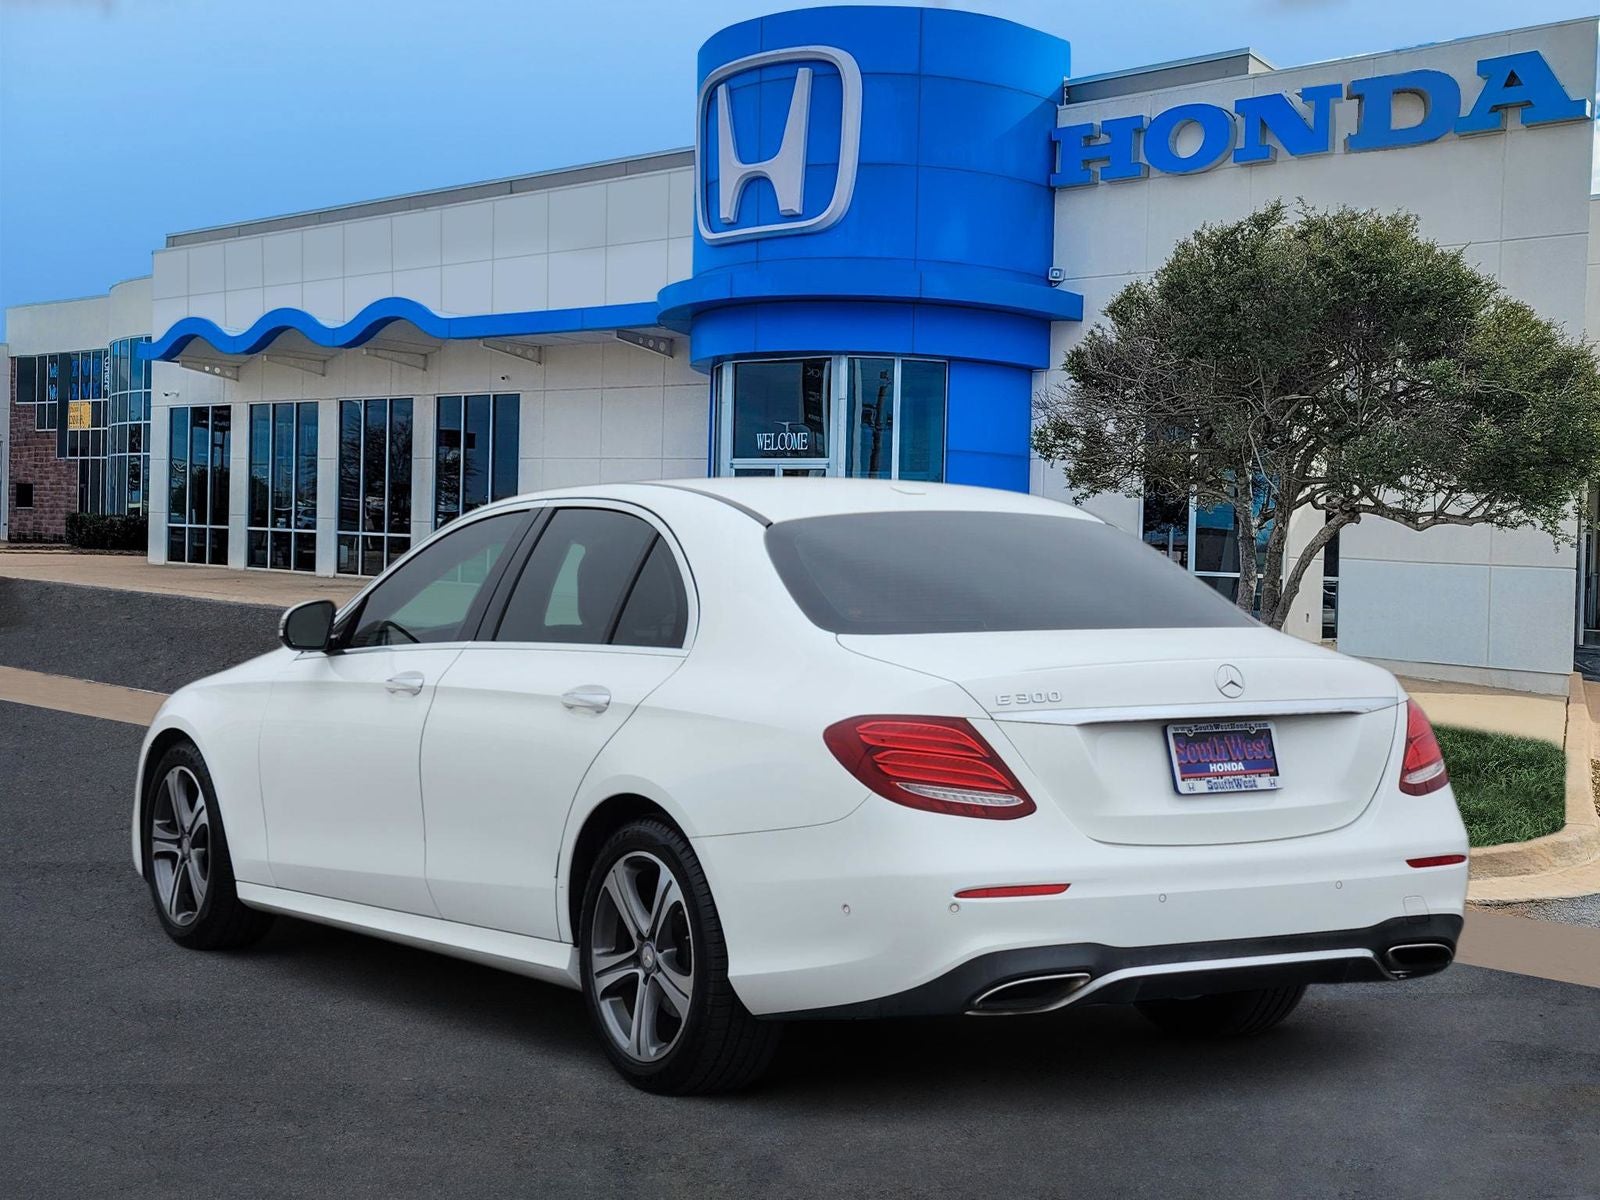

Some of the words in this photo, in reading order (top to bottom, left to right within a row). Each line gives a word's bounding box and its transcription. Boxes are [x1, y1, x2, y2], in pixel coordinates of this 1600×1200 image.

[1051, 50, 1591, 188] HONDA
[756, 432, 808, 451] WELCOME
[996, 695, 1011, 706] E
[1015, 691, 1062, 704] 300
[1209, 762, 1245, 772] HONDA
